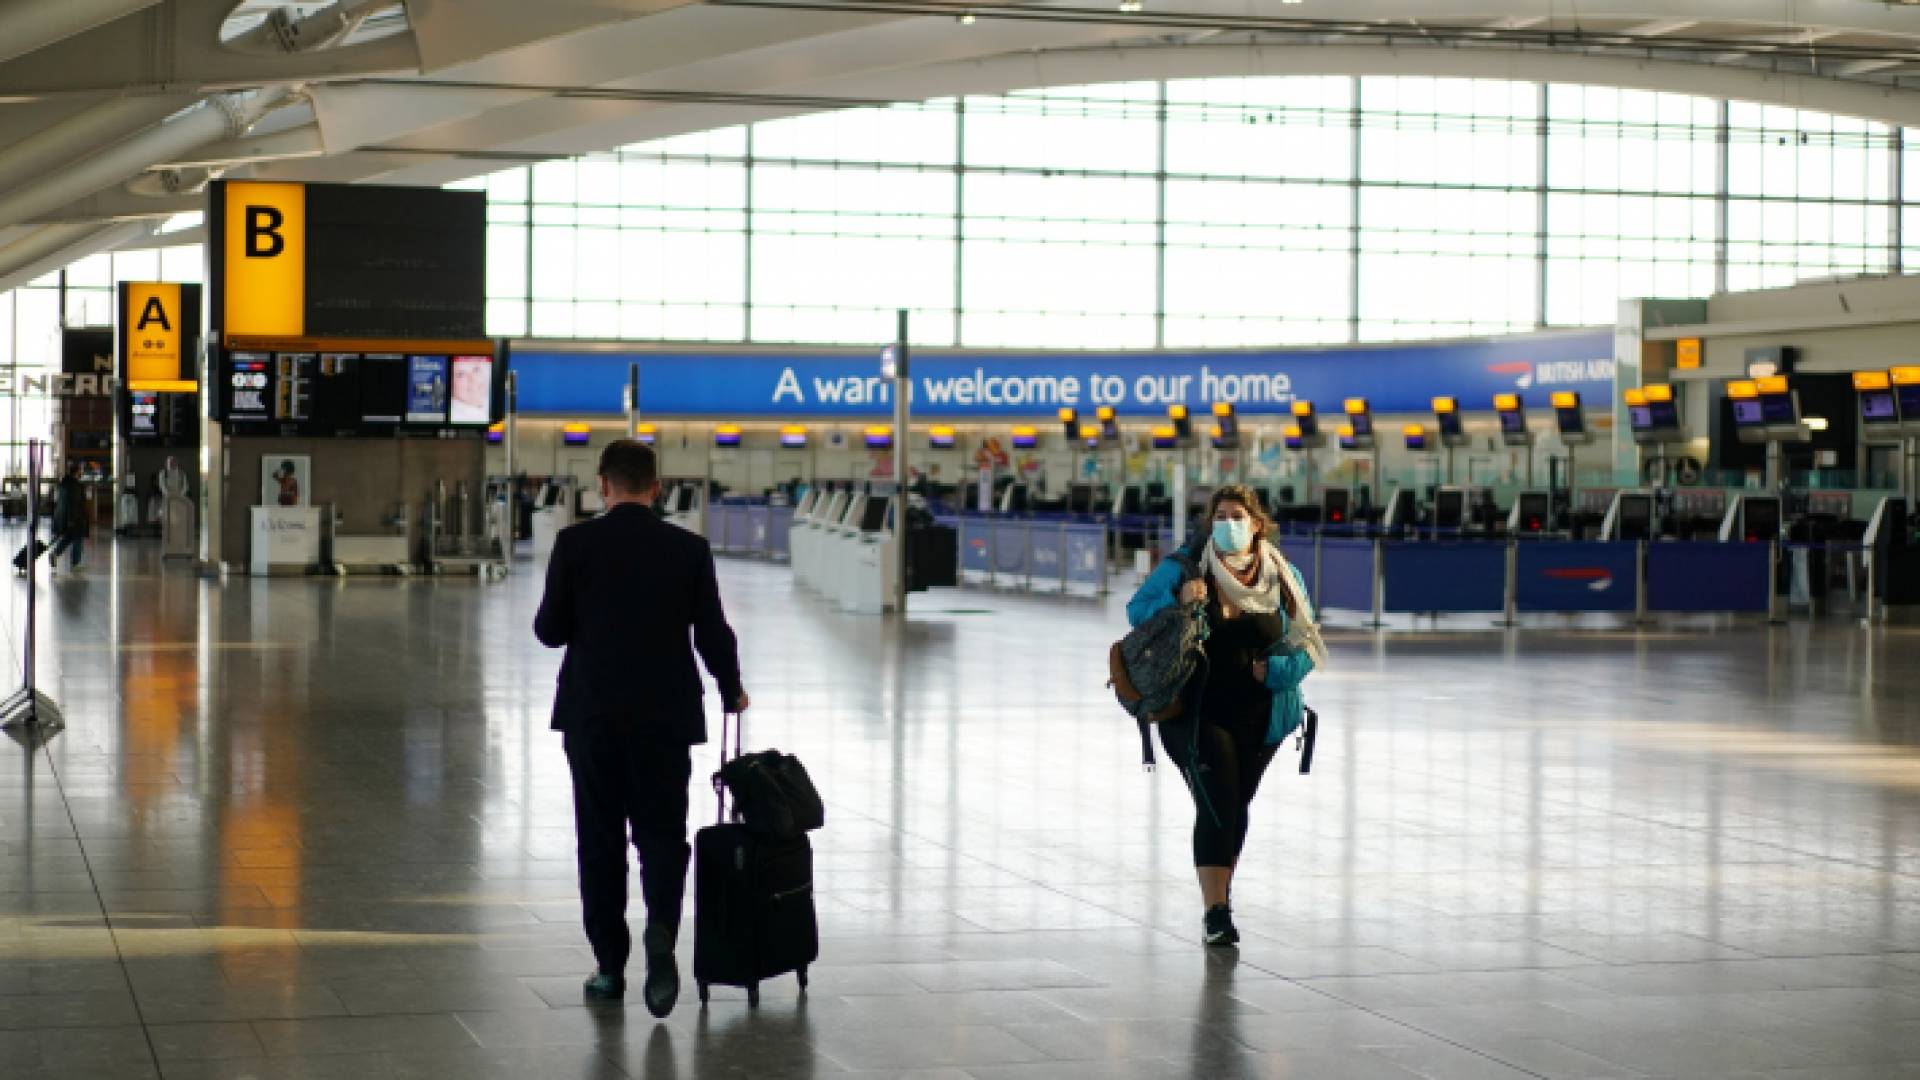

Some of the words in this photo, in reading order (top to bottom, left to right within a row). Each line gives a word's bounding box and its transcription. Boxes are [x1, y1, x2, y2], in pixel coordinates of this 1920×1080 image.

[245, 205, 284, 258] B
[137, 296, 171, 331] A
[773, 367, 804, 402] A
[923, 367, 1080, 405] welcome
[1091, 373, 1126, 403] to
[1134, 374, 1192, 404] our
[1201, 365, 1297, 403] home.
